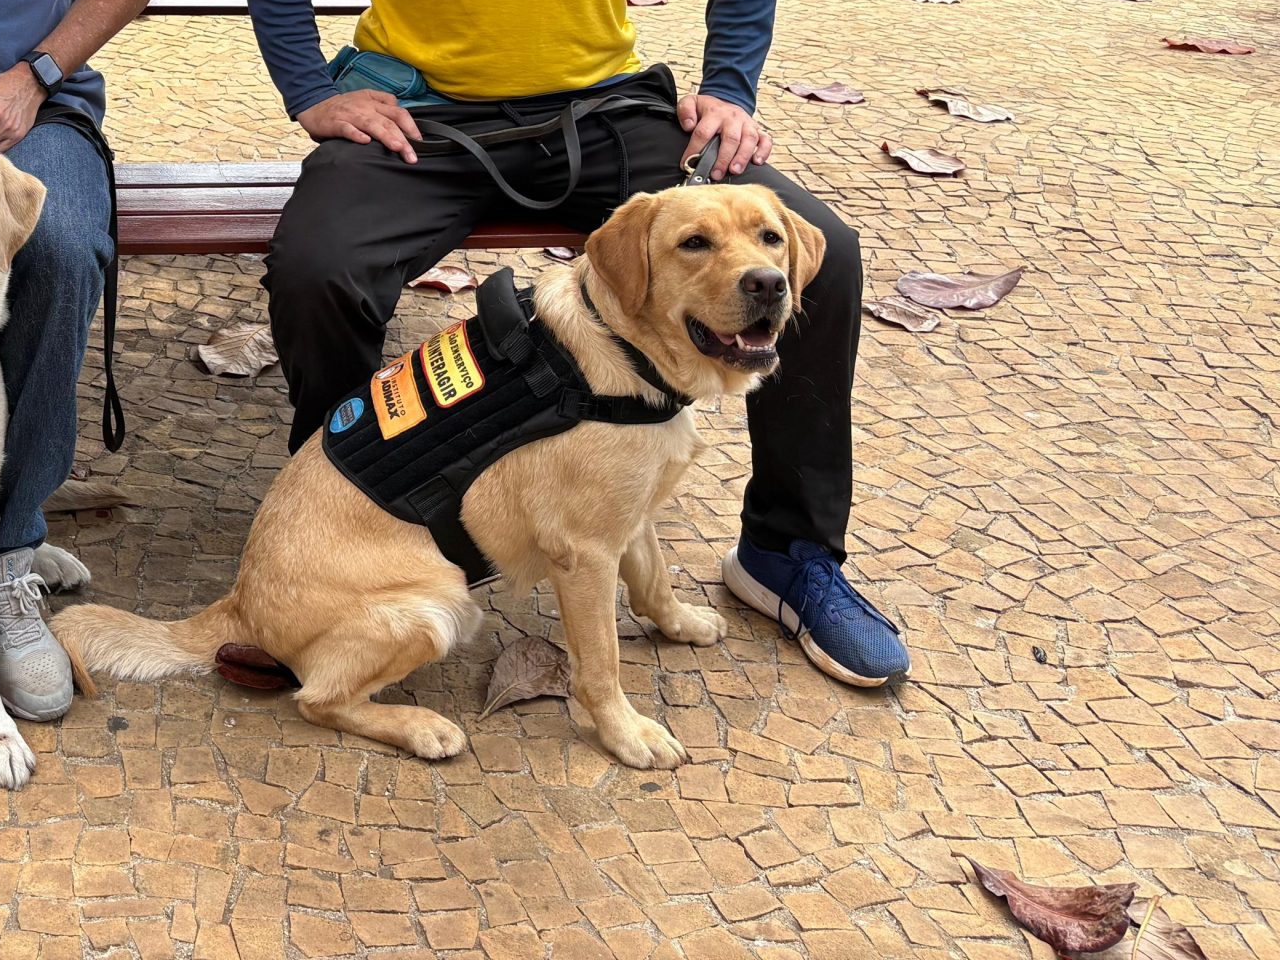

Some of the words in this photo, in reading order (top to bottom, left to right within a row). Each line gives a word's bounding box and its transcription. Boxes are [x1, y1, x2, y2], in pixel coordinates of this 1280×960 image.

[450, 343, 461, 354] EM
[427, 341, 458, 401] INTERAGIR
[454, 353, 474, 389] SERVIÇO
[381, 379, 401, 420] ADIMAX
[391, 377, 406, 416] INSTITUTO
